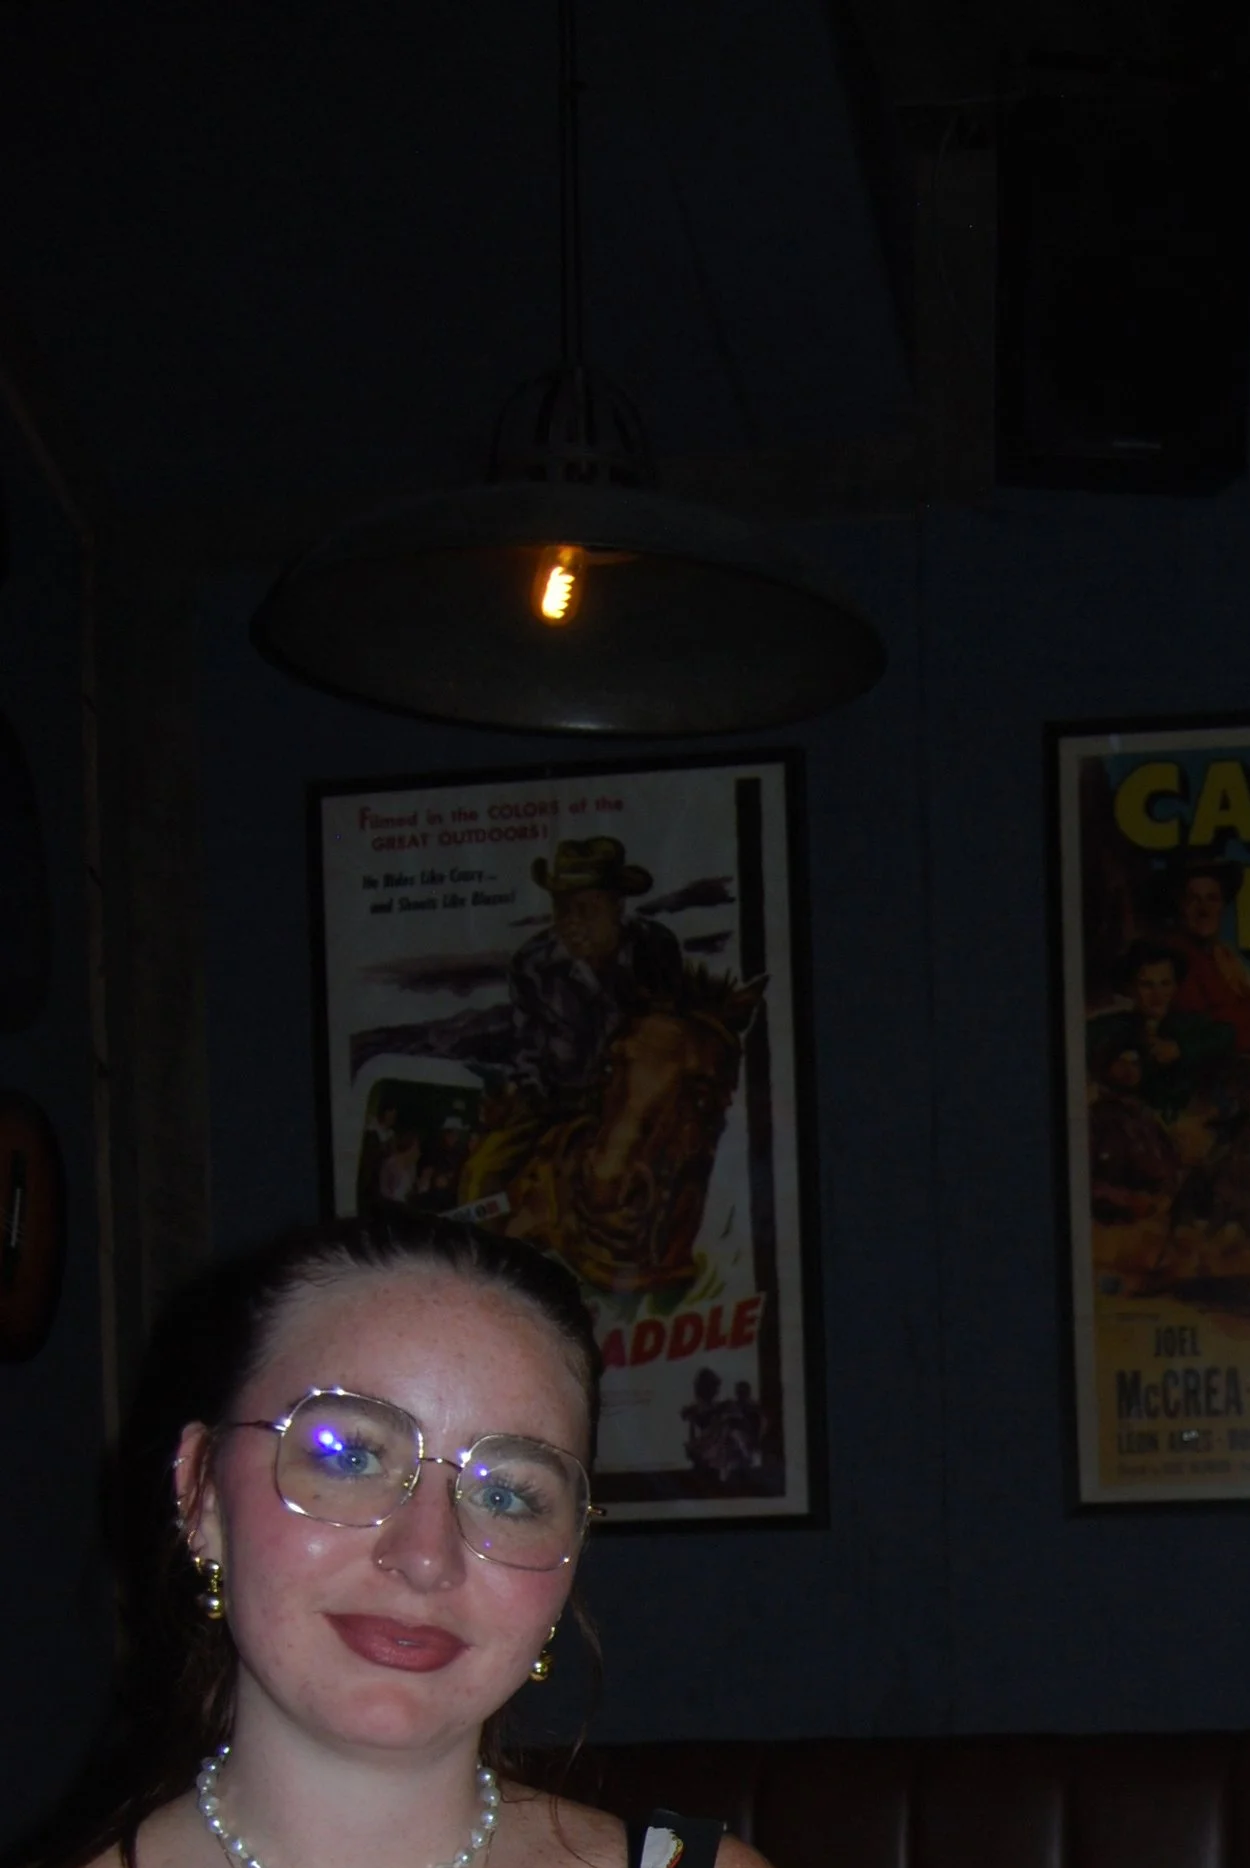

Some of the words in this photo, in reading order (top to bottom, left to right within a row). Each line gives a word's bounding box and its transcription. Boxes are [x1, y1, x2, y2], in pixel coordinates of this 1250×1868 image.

[357, 804, 419, 831] Filmed
[427, 809, 444, 825] in
[452, 806, 479, 824] the
[487, 799, 560, 820] COLORS
[568, 798, 588, 814] of
[594, 795, 624, 812] the
[371, 832, 431, 852] GREAT
[437, 824, 550, 846] OUTDOORS!
[603, 1295, 762, 1369] ADDLE
[1154, 1324, 1202, 1358] JOEL
[1116, 1365, 1245, 1420] McCREA
